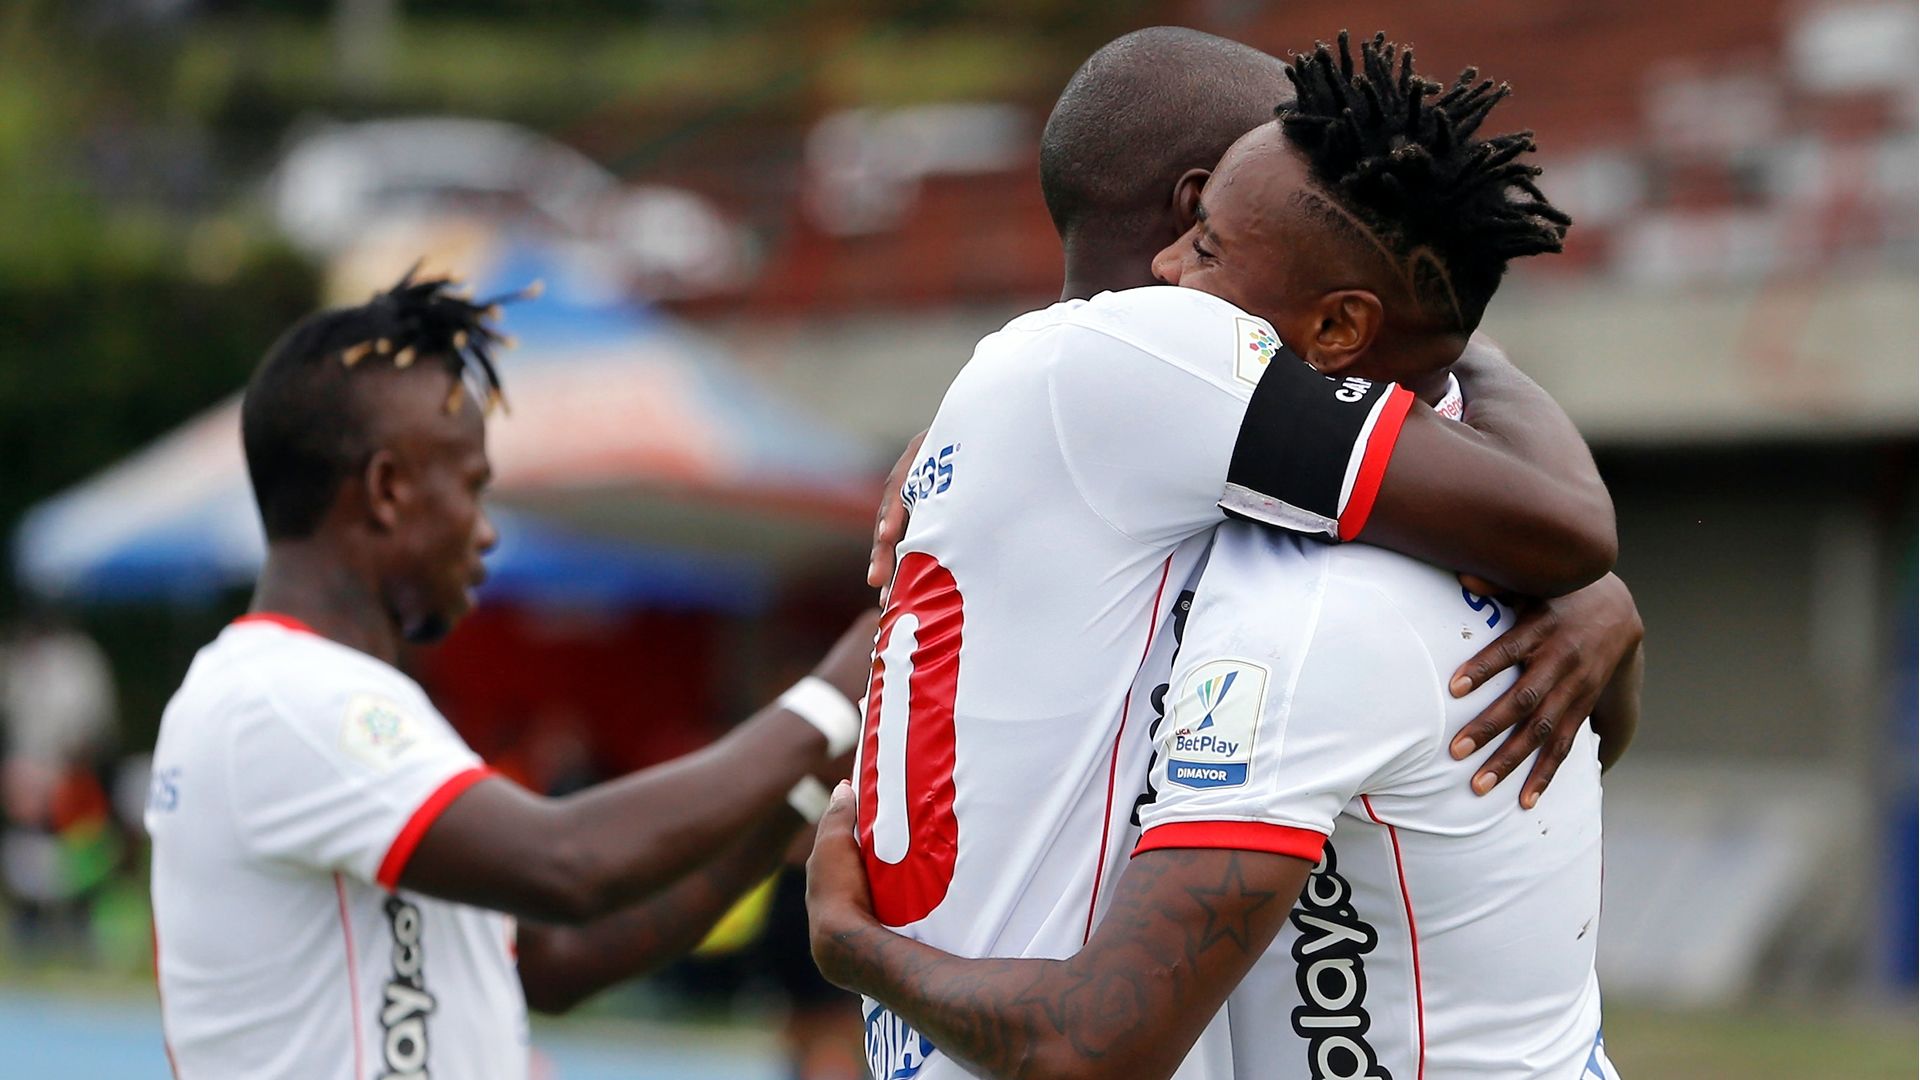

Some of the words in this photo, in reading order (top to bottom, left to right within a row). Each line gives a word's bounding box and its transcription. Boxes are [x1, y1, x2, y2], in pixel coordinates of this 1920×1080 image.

[1175, 728, 1192, 736] LIGA
[1176, 735, 1239, 758] BetPlay
[1177, 767, 1228, 781] DIMAYOR
